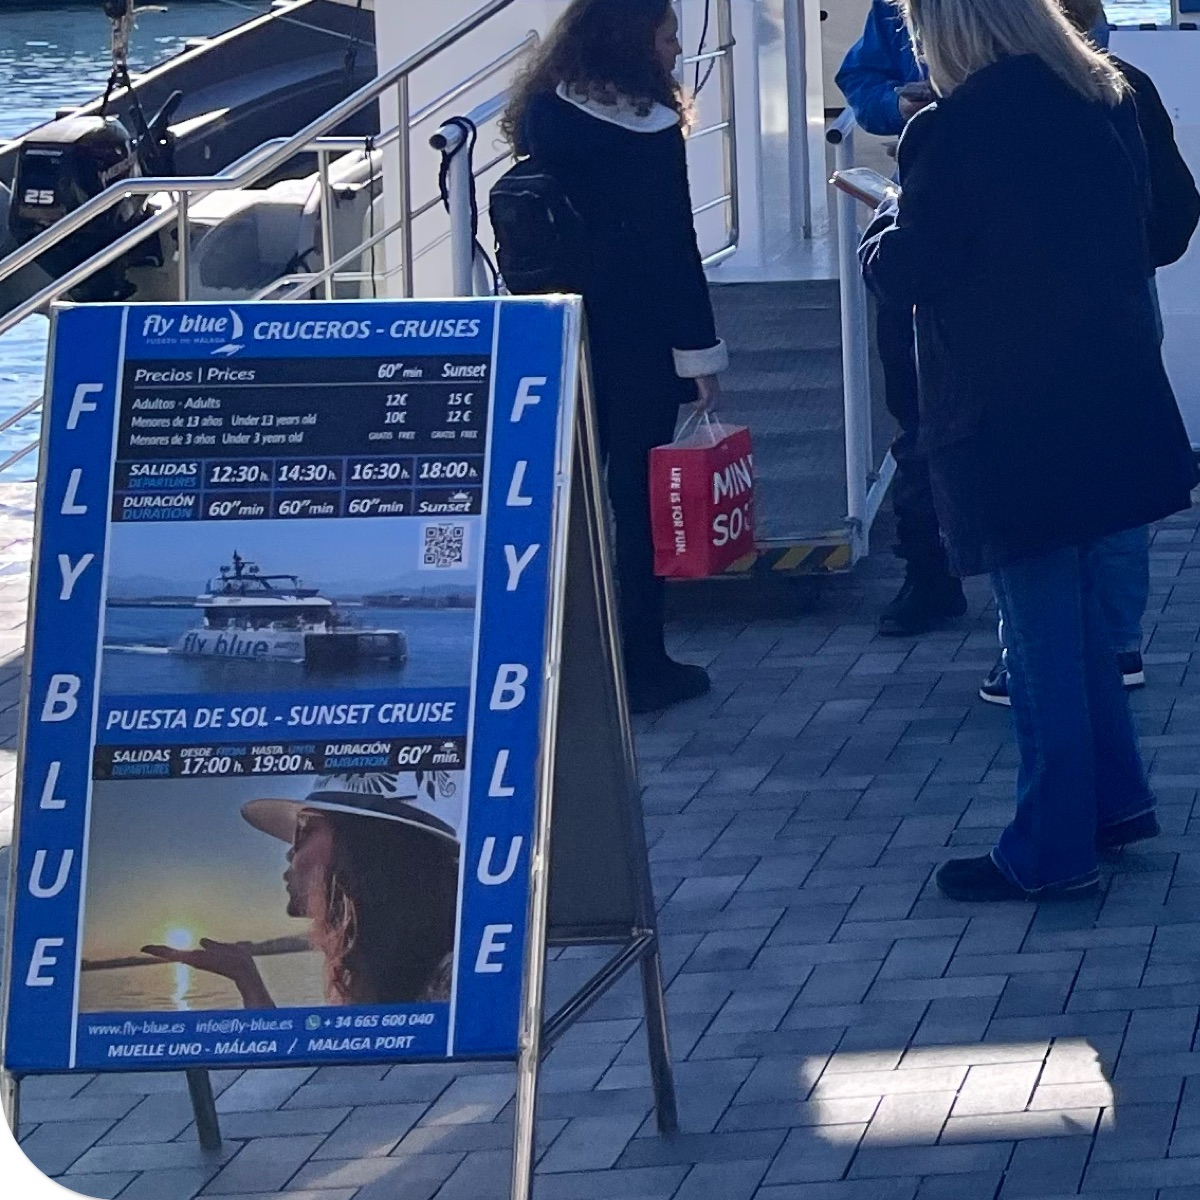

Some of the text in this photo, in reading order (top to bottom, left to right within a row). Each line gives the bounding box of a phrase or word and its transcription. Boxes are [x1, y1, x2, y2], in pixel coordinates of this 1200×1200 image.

[25, 189, 54, 204] 25
[143, 314, 481, 340] fly blue CRUCEROS CRUISES
[135, 363, 486, 382] Precios Prices Sunset
[132, 398, 175, 410] Adultos
[184, 397, 221, 409] Adults
[131, 416, 171, 428] Menores
[172, 416, 184, 427] de
[186, 416, 200, 427] 13
[201, 414, 223, 426] años
[231, 414, 259, 426] Under
[261, 415, 273, 426] 13
[276, 414, 299, 427] years
[301, 413, 317, 425] old
[130, 434, 169, 446] Menores
[171, 434, 183, 445] de
[185, 433, 192, 445] 3
[222, 433, 250, 444] Under
[254, 432, 260, 443] 3
[261, 433, 287, 446] years
[288, 431, 304, 443] old
[129, 463, 198, 476] SALIDAS
[671, 467, 682, 489] LIFE
[713, 454, 753, 504] MIN
[123, 493, 471, 513] DURACIÓN Sunset
[671, 492, 681, 503] IS
[122, 508, 193, 520] DURATION
[671, 506, 684, 526] FOR
[25, 382, 104, 988] FLY BLUE
[474, 376, 548, 975] FLY BLUE
[106, 702, 456, 730] PUESTA DE SOL SUNSET CRUISE
[112, 749, 171, 763] SALIDAS
[180, 747, 212, 757] DESDE
[251, 745, 284, 756] HASTA
[324, 741, 391, 756] DURACIÓN
[180, 756, 232, 775] 17:00
[251, 754, 302, 773] 19:00
[88, 1020, 186, 1036] www.fly-blue.es
[195, 1018, 293, 1034] info@fly-blue.es
[333, 1015, 352, 1029] 34
[408, 1012, 435, 1026] 040
[107, 1035, 416, 1058] MUELLE UNO MÁLAGA MALAGA PORT
